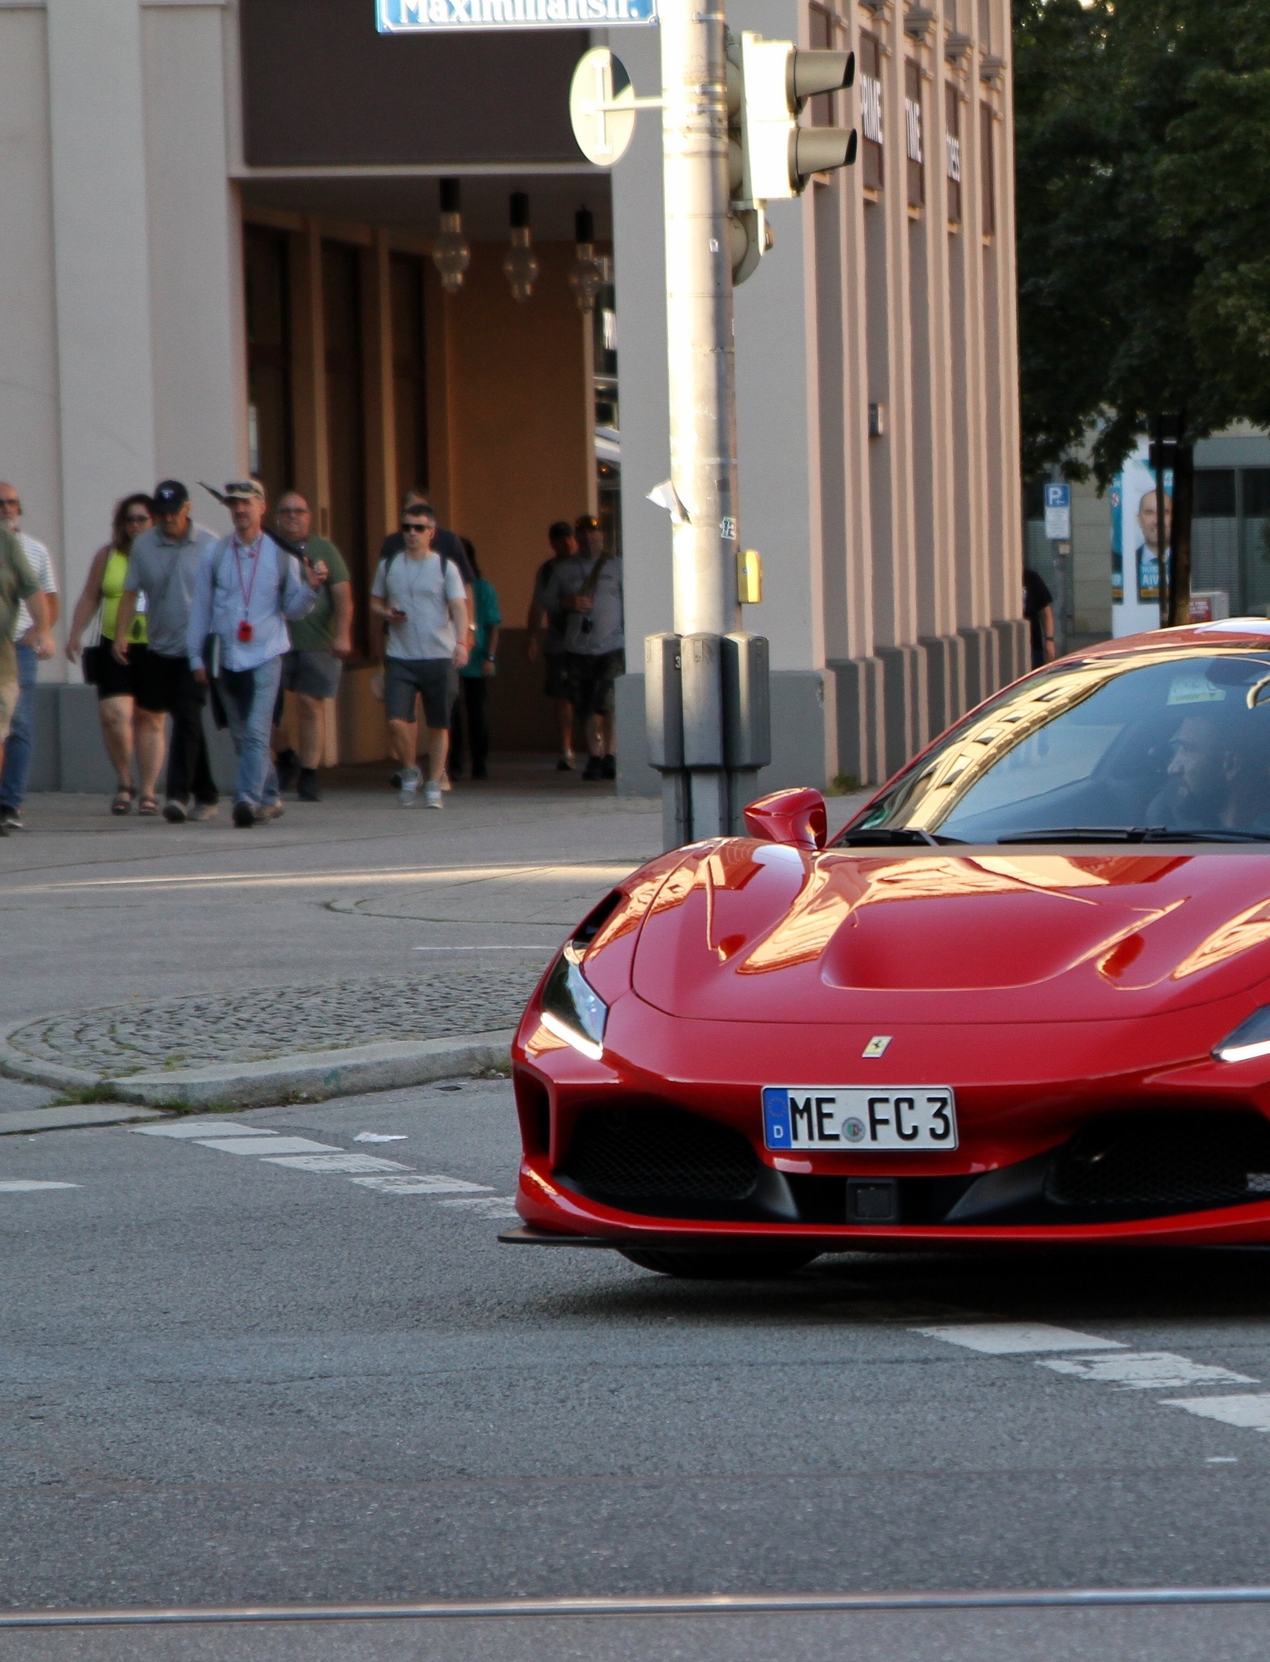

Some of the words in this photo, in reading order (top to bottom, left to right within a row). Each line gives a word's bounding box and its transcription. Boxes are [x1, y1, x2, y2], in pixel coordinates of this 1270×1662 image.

[860, 73, 883, 145] PRIME
[905, 97, 922, 163] TIME
[773, 1125, 784, 1138] D
[789, 1097, 840, 1141] ME
[868, 1097, 918, 1141] FC
[926, 1097, 950, 1140] 3
